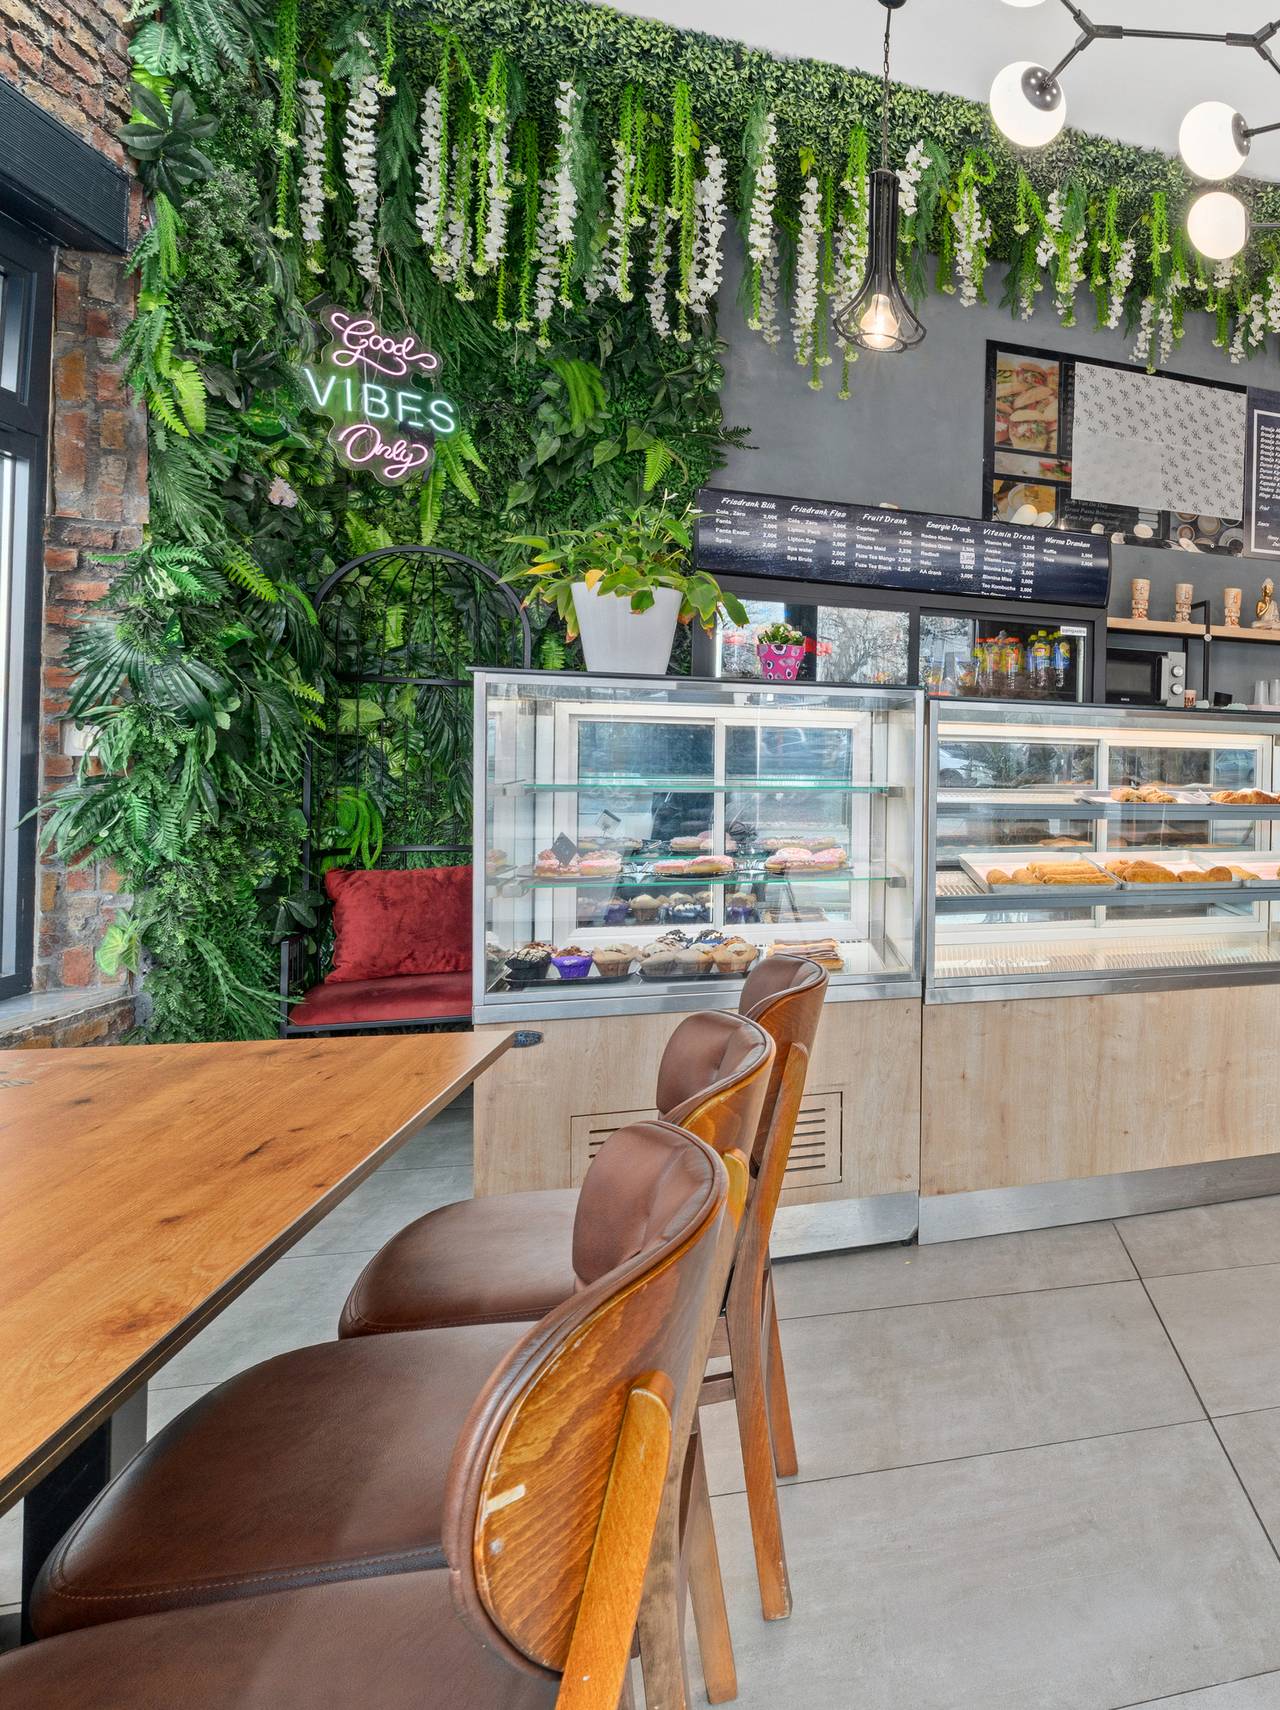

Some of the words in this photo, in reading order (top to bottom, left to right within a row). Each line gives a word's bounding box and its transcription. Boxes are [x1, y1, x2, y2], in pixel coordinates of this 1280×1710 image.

[331, 312, 438, 375] Good
[303, 367, 455, 433] VIBES
[337, 424, 428, 479] Only
[721, 498, 759, 508] Frisdrank
[760, 502, 777, 510] Blik
[790, 505, 828, 516] Frisdrank
[863, 514, 883, 522] Fruit
[884, 516, 908, 525] Drank
[926, 521, 951, 532] Energie
[952, 524, 971, 533] Drank
[983, 529, 1012, 538] Vitamin
[1013, 532, 1035, 541] Drank
[1045, 537, 1065, 545] Warme
[1066, 539, 1090, 548] Dranken
